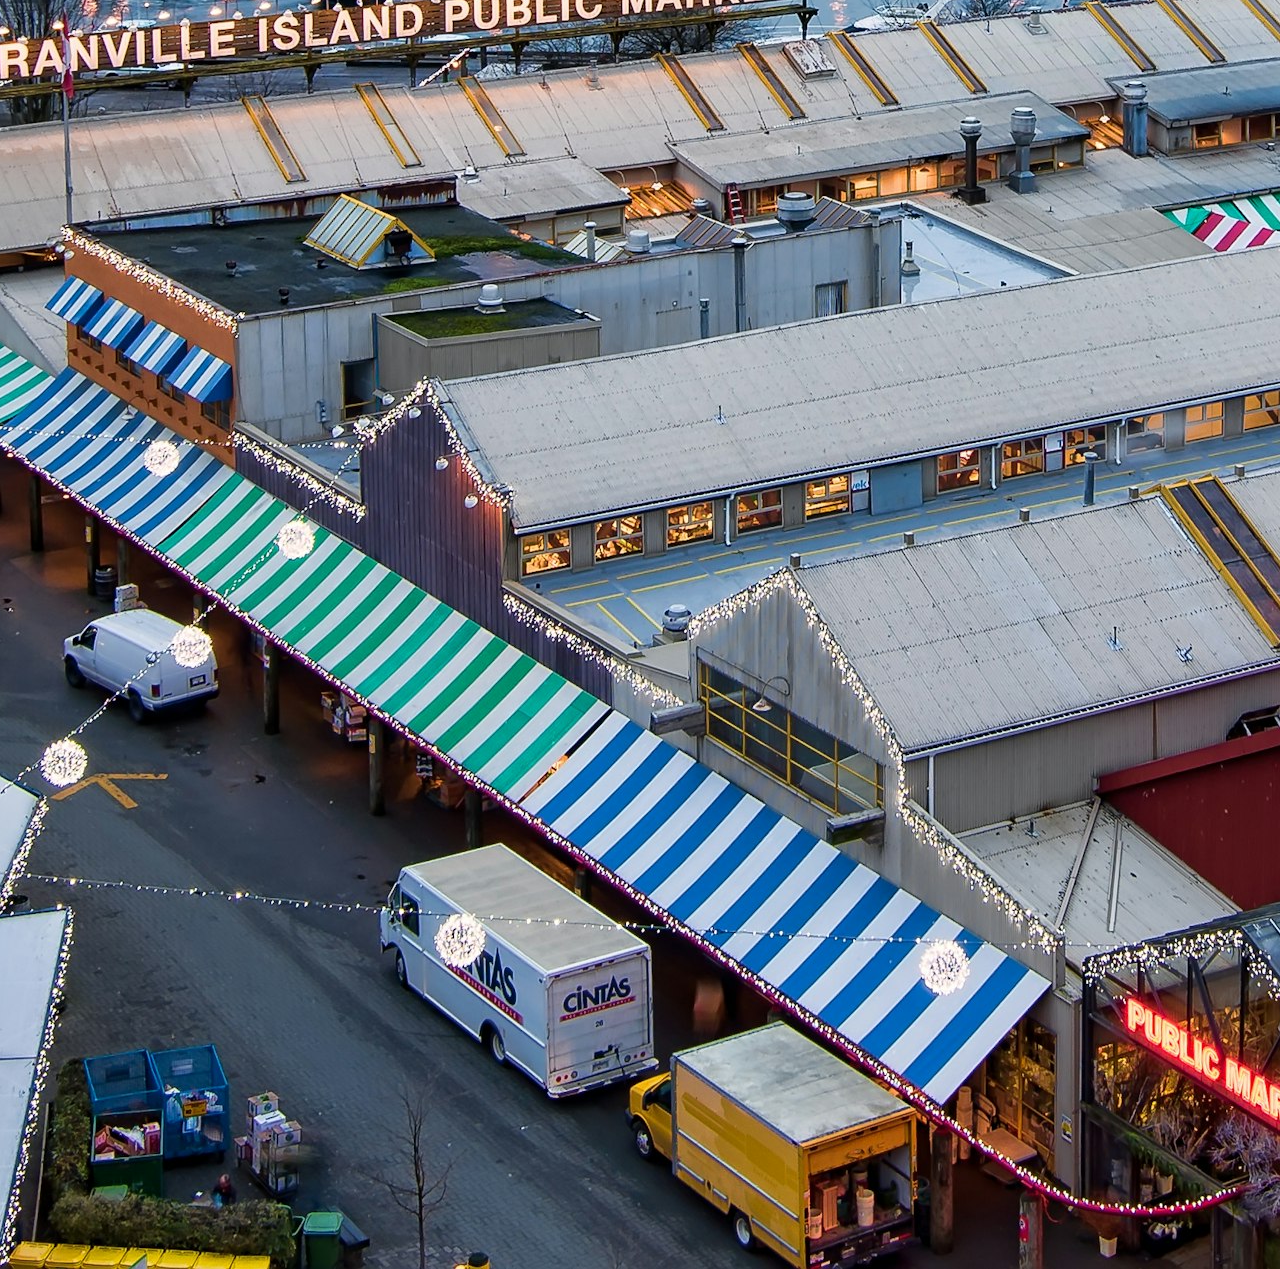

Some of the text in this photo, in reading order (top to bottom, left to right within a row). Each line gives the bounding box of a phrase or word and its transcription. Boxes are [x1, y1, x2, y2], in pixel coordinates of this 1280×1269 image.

[258, 3, 424, 52] ISLAND
[465, 947, 517, 1006] NTAS
[563, 975, 632, 1013] CINTAS
[1127, 997, 1220, 1082] PUBLIC
